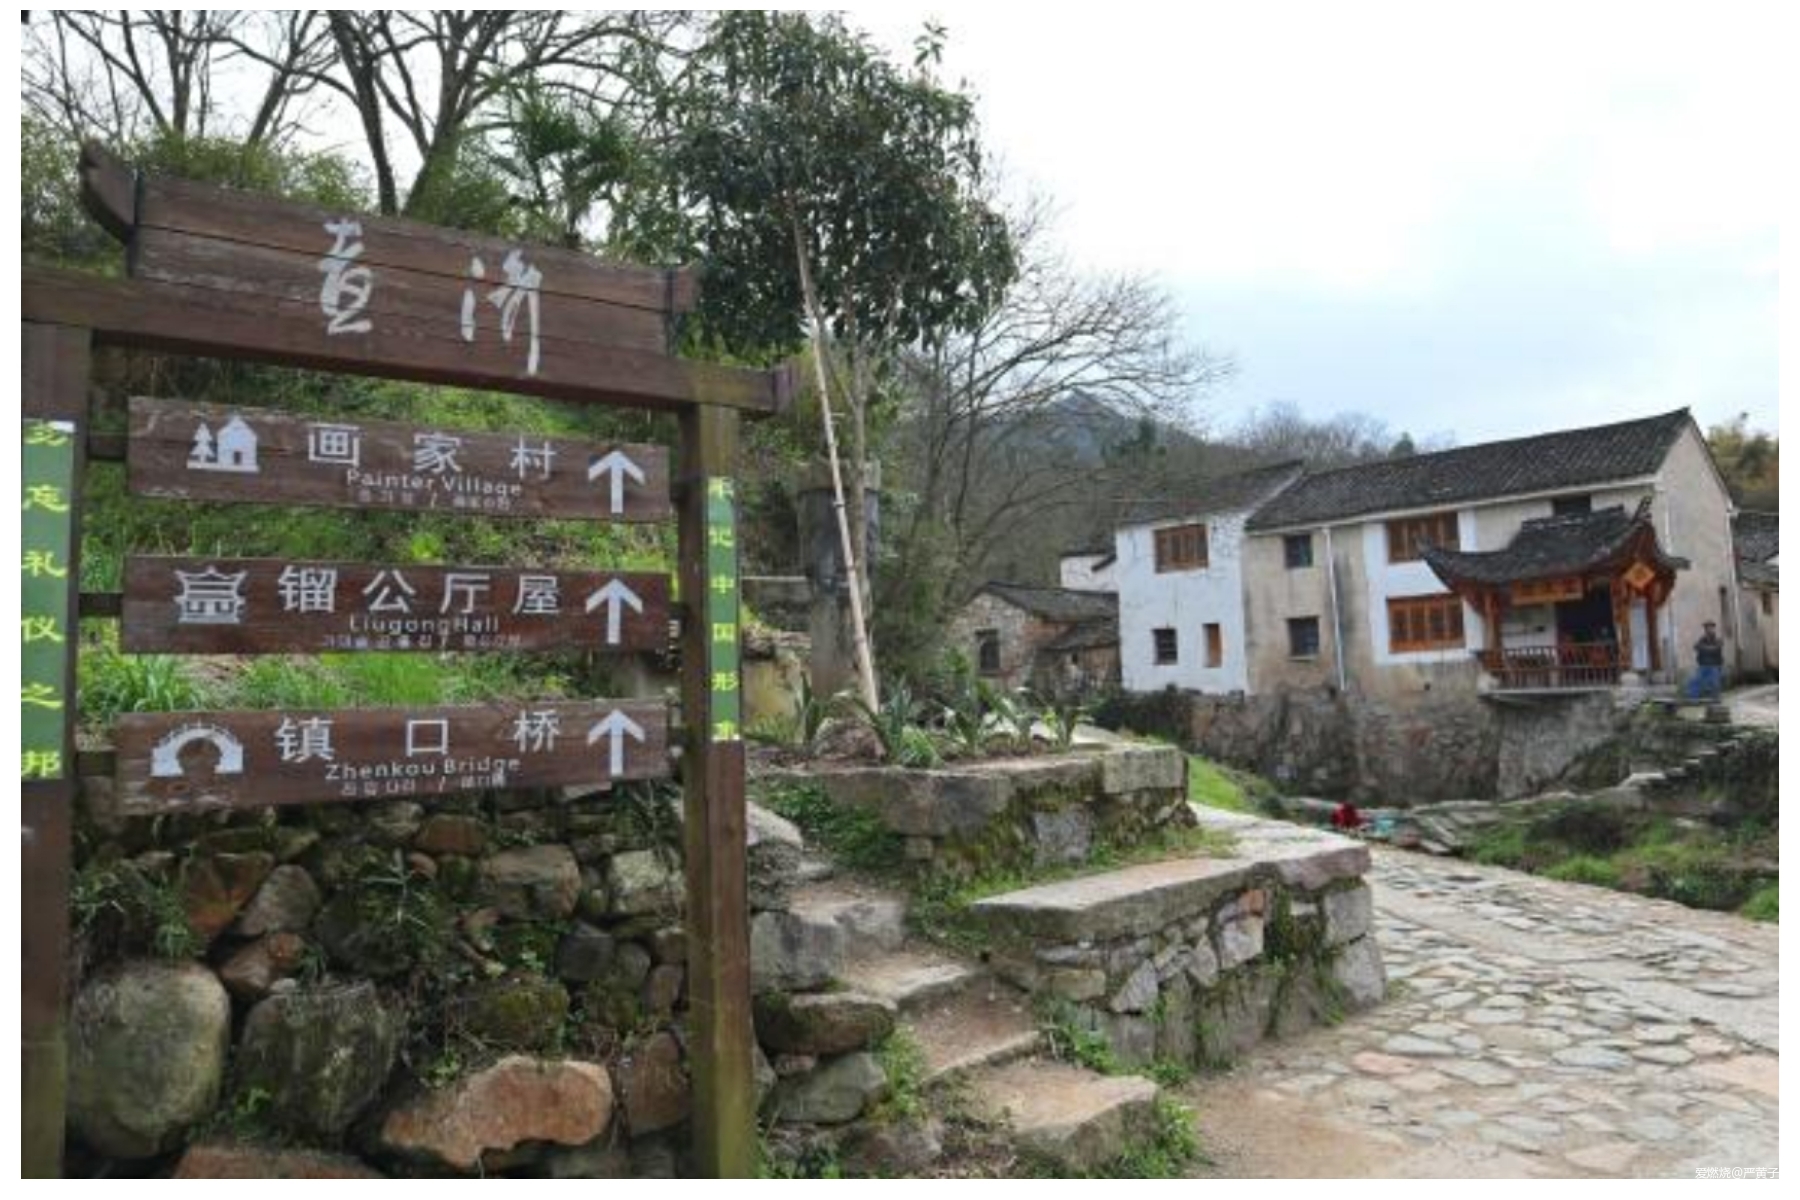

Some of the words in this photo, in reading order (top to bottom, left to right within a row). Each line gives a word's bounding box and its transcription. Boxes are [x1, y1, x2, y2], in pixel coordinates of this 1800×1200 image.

[308, 422, 556, 479] 画家村
[347, 467, 434, 491] Painter
[442, 473, 522, 496] Village
[278, 564, 560, 615] 镏公厅屋
[275, 708, 560, 763] 镇口桥
[325, 761, 435, 781] Zhenkou
[444, 756, 521, 776] Bridge
